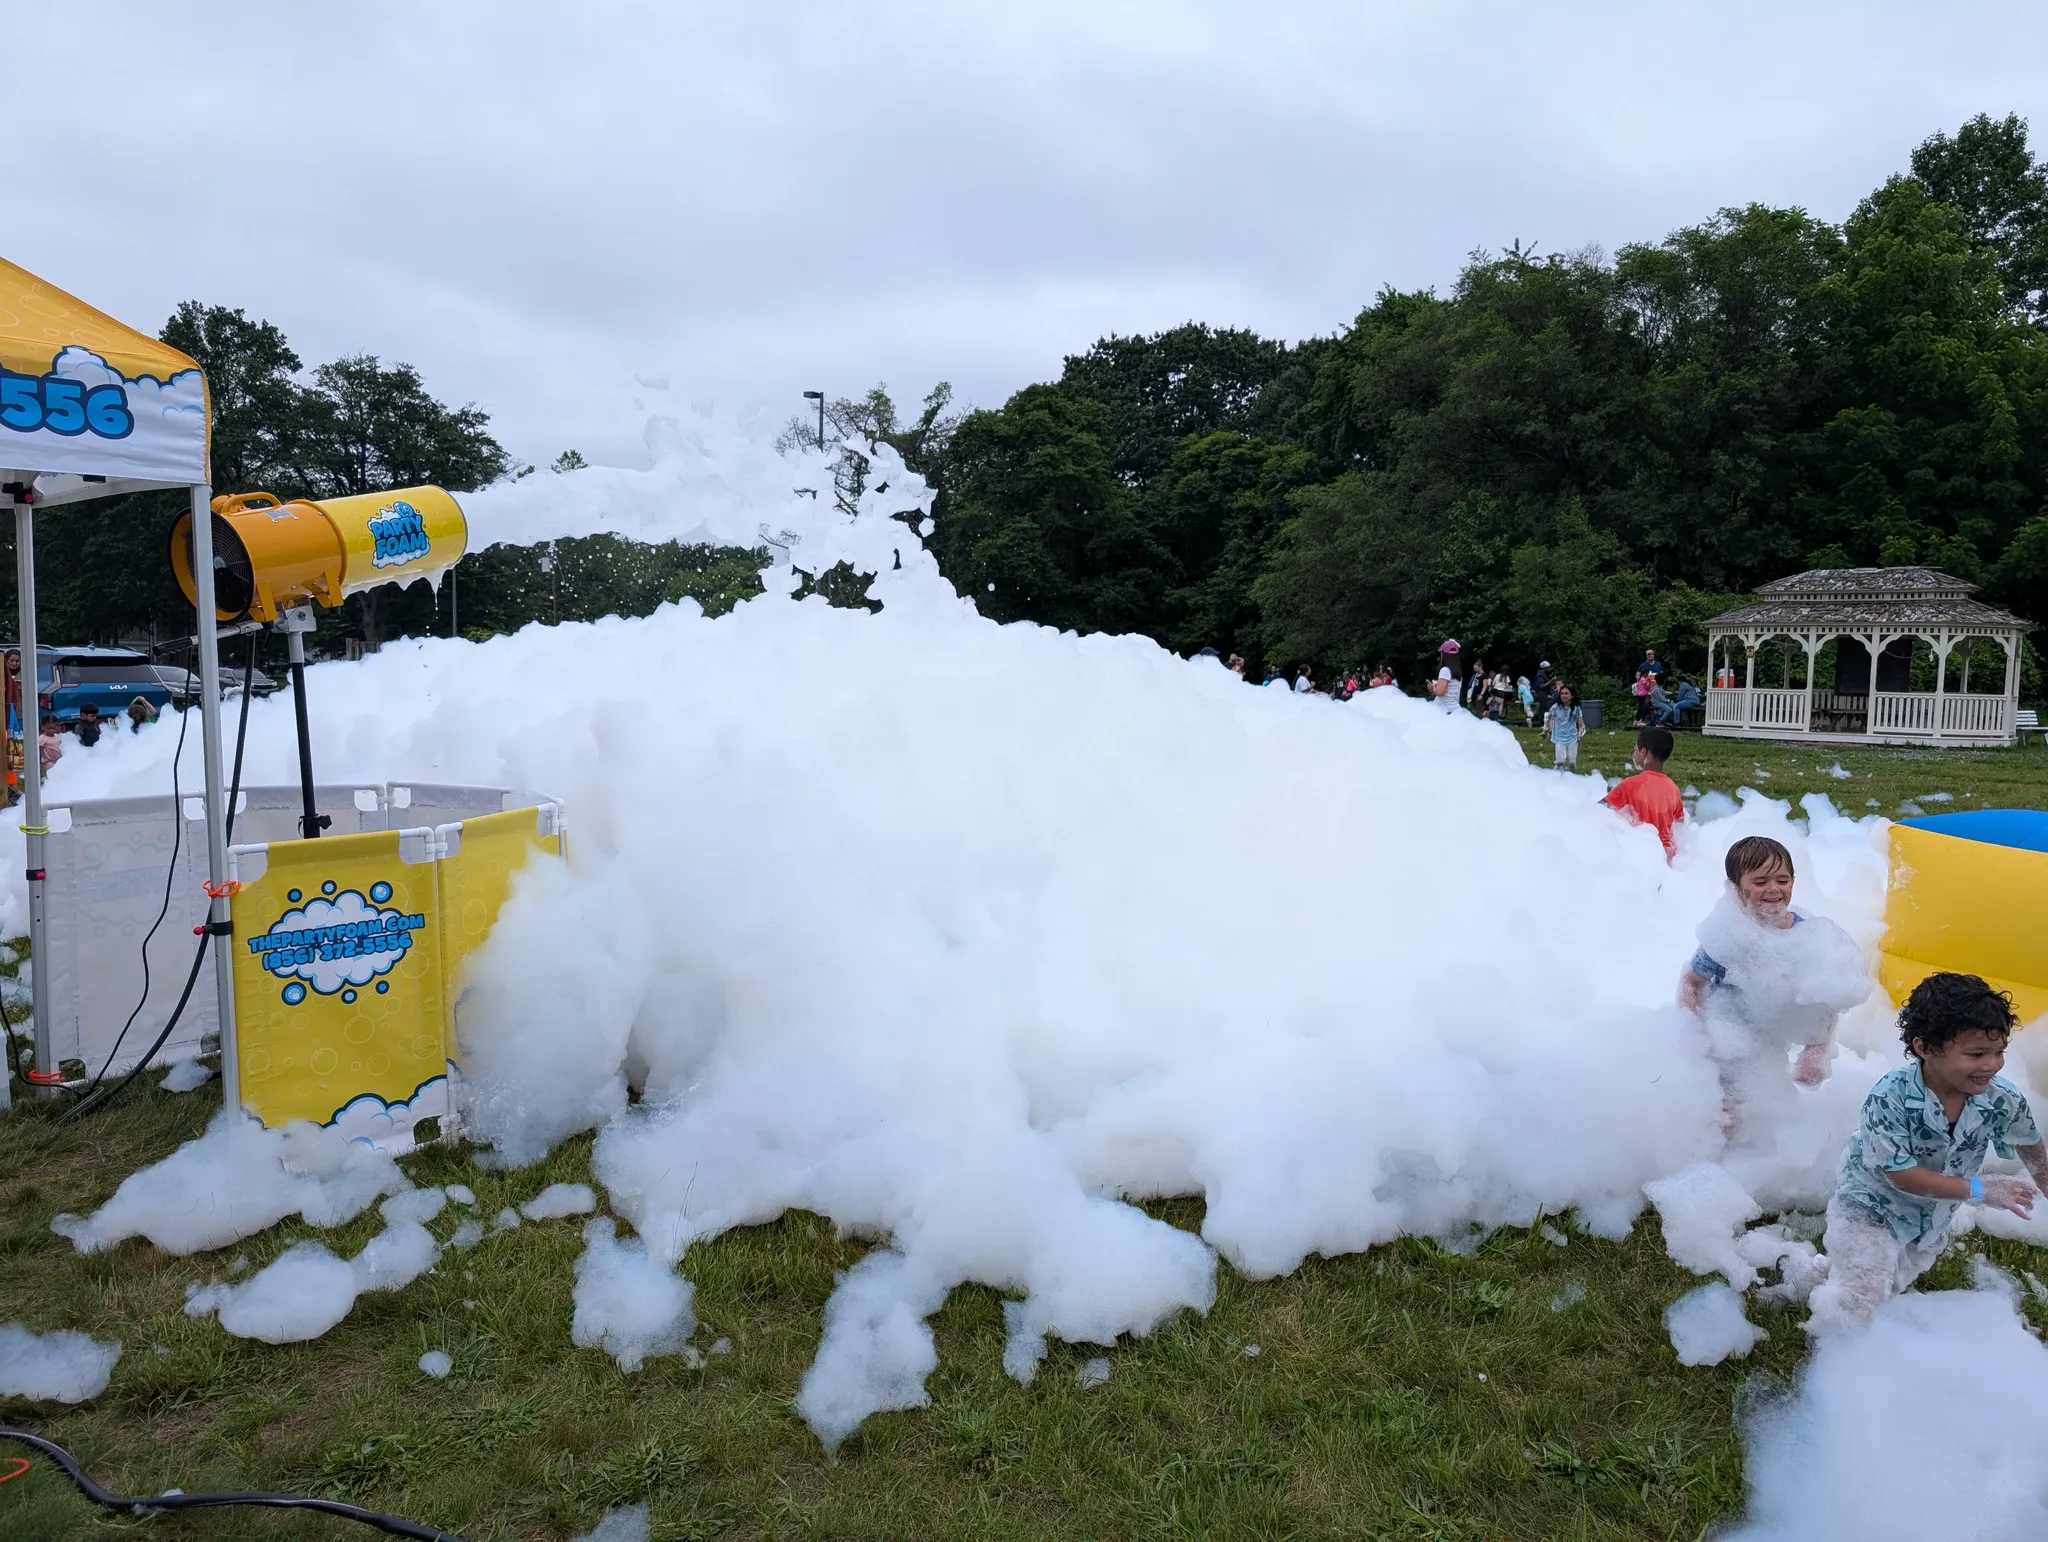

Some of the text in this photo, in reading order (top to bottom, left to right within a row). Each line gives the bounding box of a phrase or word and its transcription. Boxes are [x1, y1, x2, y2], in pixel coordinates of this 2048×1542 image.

[0, 376, 132, 437] 556
[371, 514, 422, 540] PARTY
[376, 531, 426, 559] FOAM
[248, 914, 425, 953] THEPARTYFOAM.COM
[262, 932, 413, 971] (856) 372-5556
